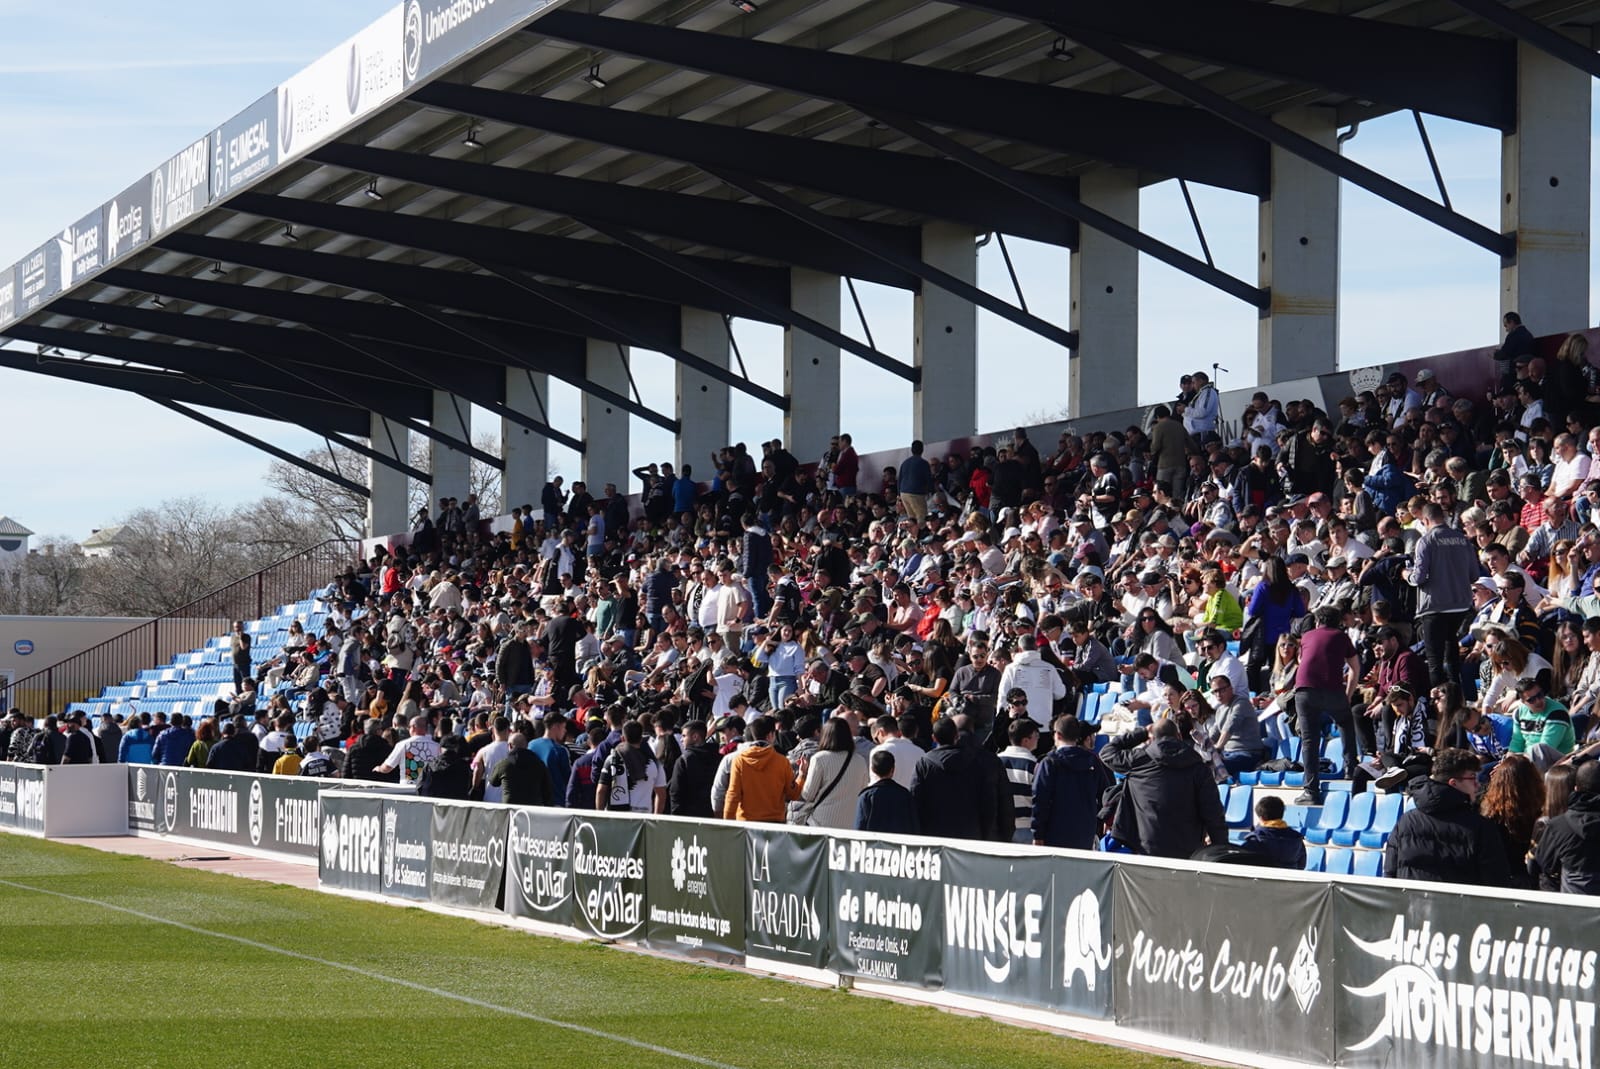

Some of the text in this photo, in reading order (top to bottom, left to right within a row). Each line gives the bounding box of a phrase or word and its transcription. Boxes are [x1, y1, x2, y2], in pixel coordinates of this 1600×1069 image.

[425, 0, 472, 44] Unionistas
[230, 118, 269, 170] SUMESAL
[339, 814, 380, 875] errea
[432, 838, 458, 861] manuel
[512, 826, 569, 860] autoescuelas
[575, 841, 644, 879] autoescuelas
[752, 838, 771, 883] LA
[828, 838, 847, 871] La
[524, 860, 568, 904] el pilar
[587, 880, 643, 931] el pilar
[668, 911, 675, 925] en
[700, 911, 707, 930] de
[720, 920, 731, 937] gas
[752, 889, 811, 941] PARADA
[839, 889, 923, 931] de Merino
[848, 931, 876, 952] Federico
[876, 935, 884, 952] de
[900, 939, 909, 956] 42
[1127, 929, 1286, 1001] Monte Carlo
[1384, 914, 1598, 989] Artes Gráficas
[857, 958, 898, 980] SALAMANCA
[1384, 976, 1596, 1069] MONTSERRAT
